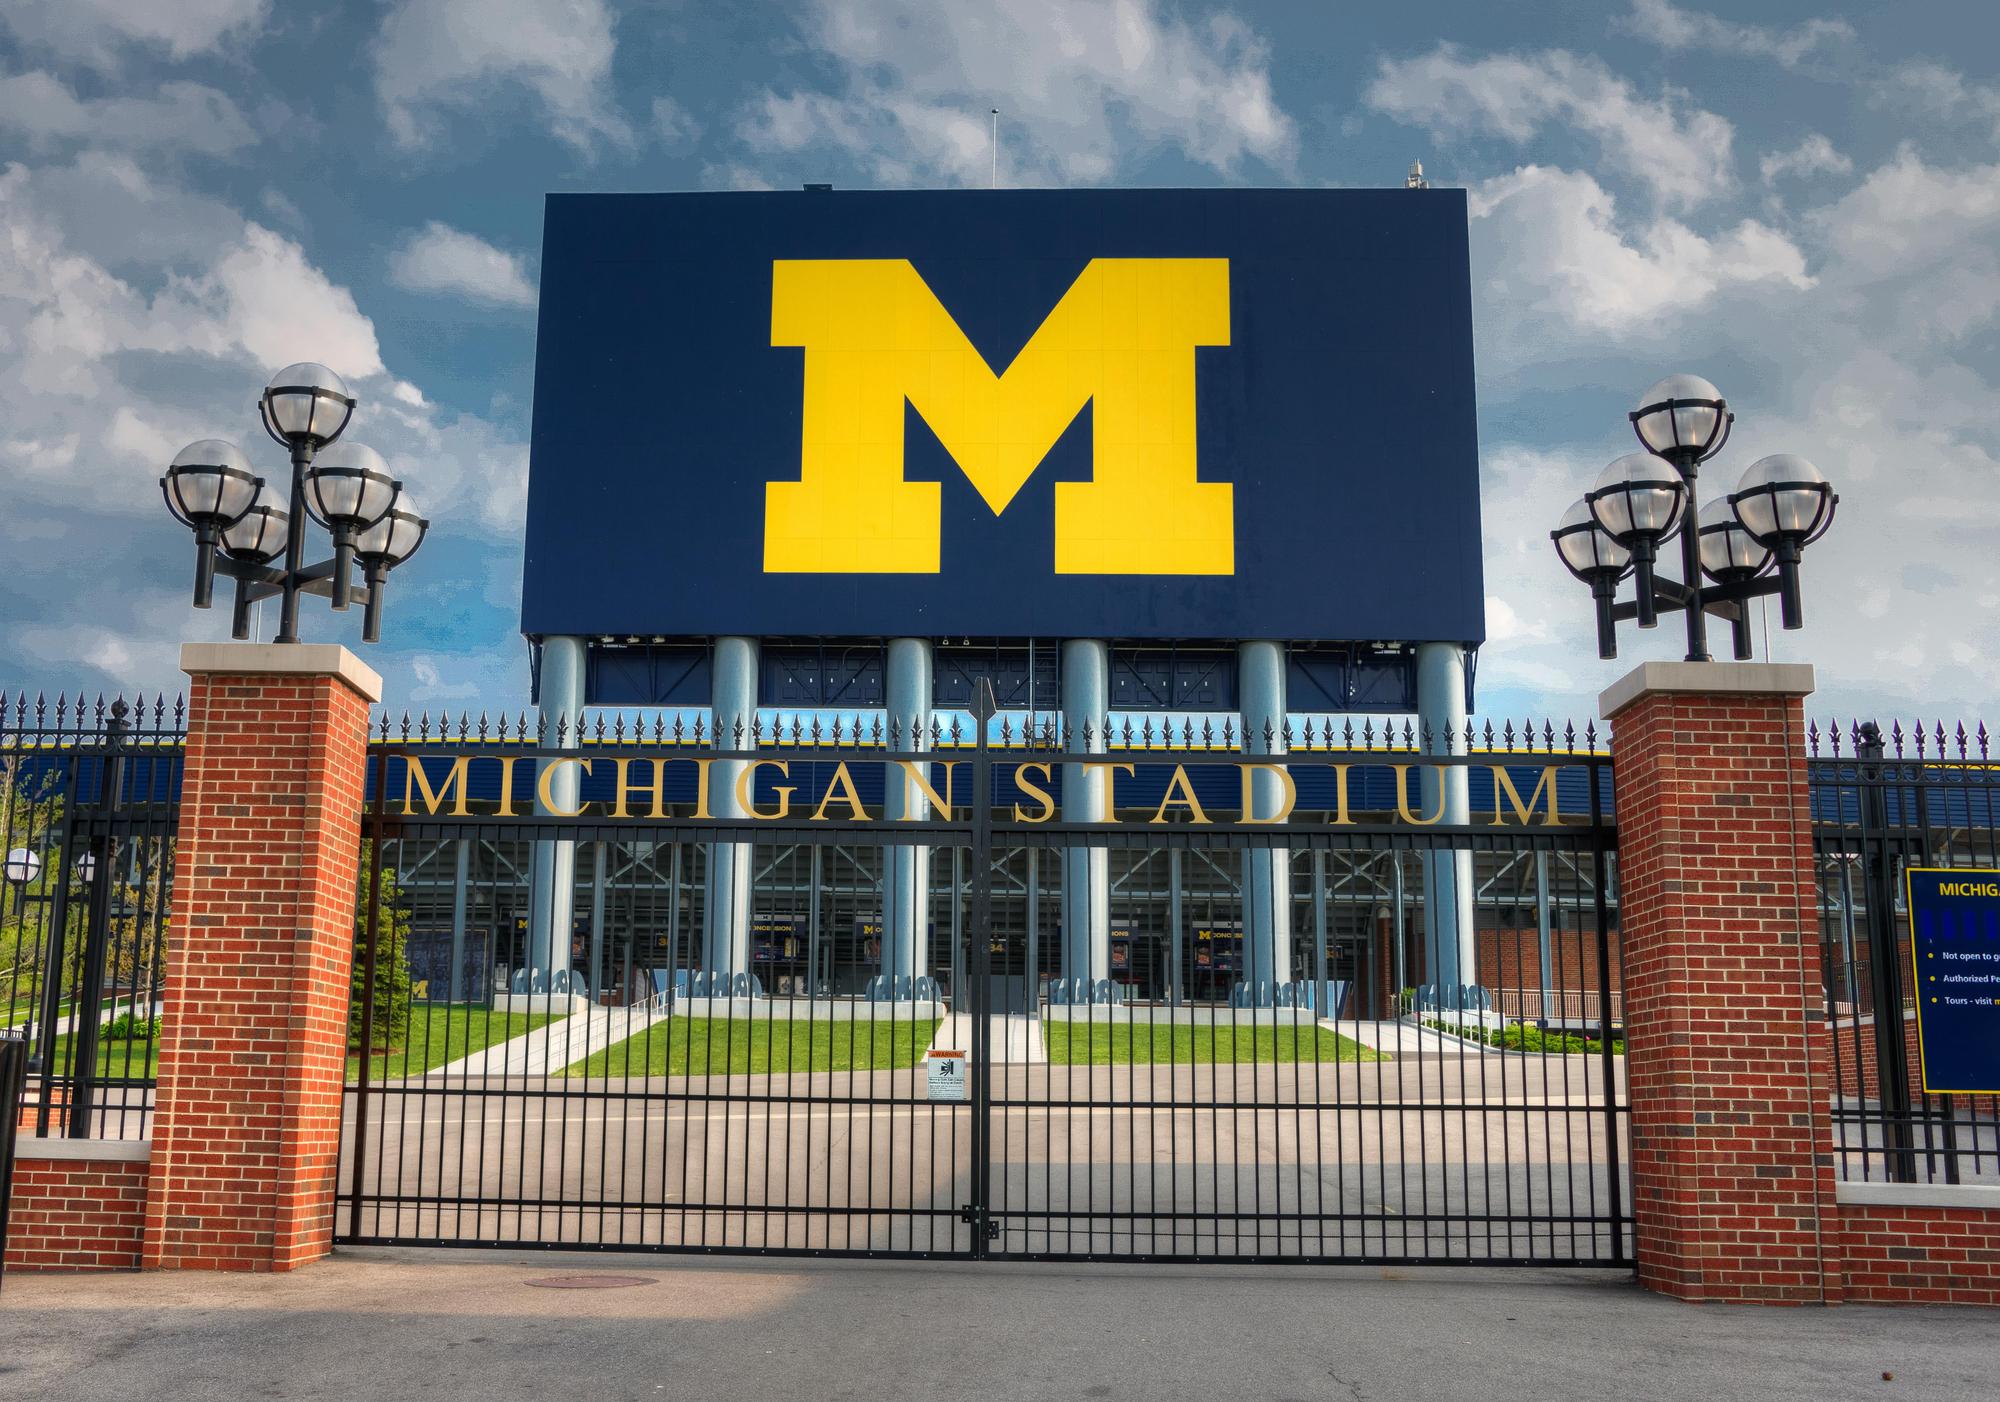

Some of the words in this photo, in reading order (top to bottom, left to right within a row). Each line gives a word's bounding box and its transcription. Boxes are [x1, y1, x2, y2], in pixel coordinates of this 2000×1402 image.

[762, 257, 1235, 576] M
[401, 756, 954, 823] MICHIGAN
[1013, 761, 1568, 827] STADIUM
[1939, 883, 2000, 896] MICHIG
[1199, 930, 1211, 940] M
[1942, 952, 1958, 961] Not
[1960, 953, 1981, 962] open
[1982, 953, 1992, 961] to
[1943, 974, 1989, 984] Authorized
[1944, 996, 1968, 1006] Tours
[1975, 996, 1993, 1006] visit
